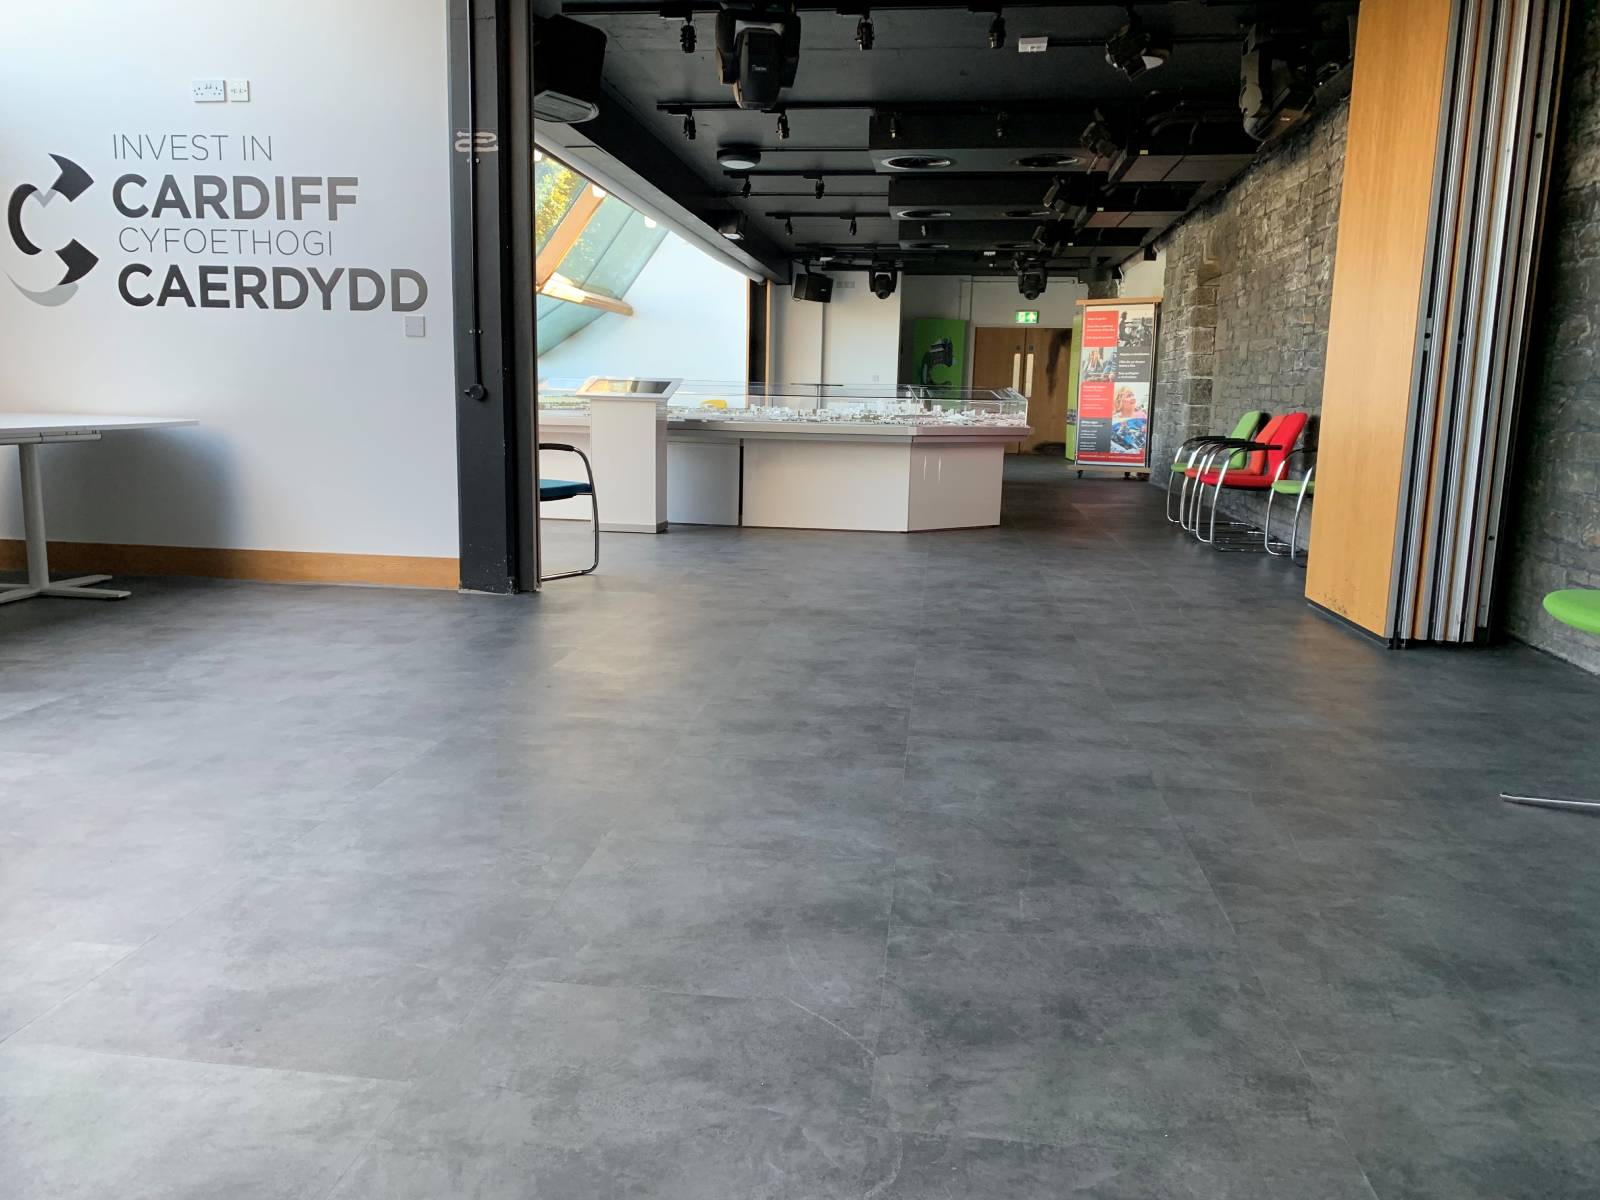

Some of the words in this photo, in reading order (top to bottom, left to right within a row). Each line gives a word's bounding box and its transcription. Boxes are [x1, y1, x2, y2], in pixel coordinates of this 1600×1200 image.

[113, 134, 229, 161] INVEST
[243, 136, 273, 162] IN
[113, 174, 359, 221] CARDIFF
[119, 227, 332, 256] CYFOETHOGI
[118, 263, 428, 312] CAERDYDD
